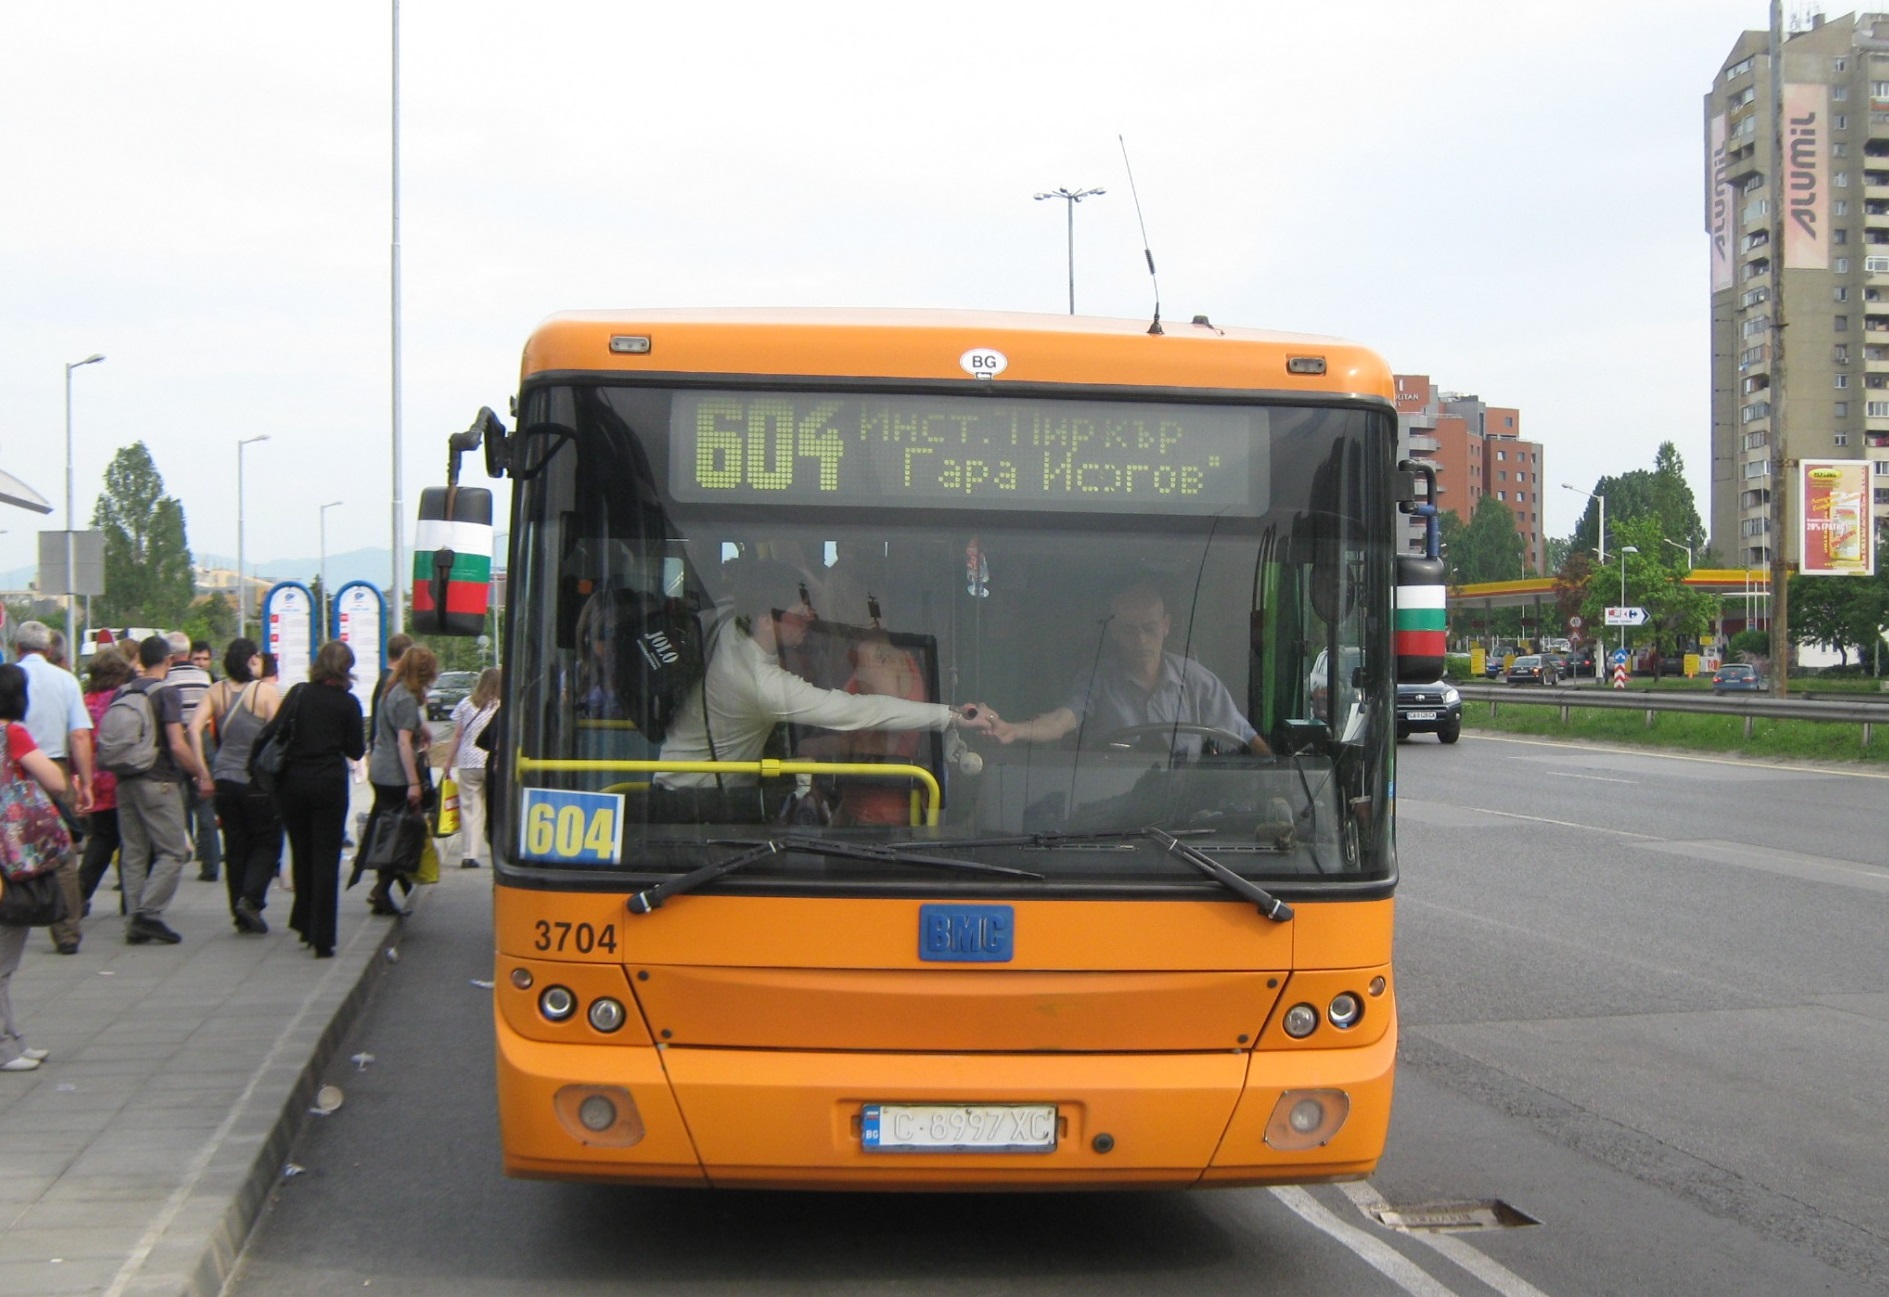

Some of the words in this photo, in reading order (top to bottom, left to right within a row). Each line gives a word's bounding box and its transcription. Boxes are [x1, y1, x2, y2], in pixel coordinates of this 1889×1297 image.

[972, 355, 997, 369] BG
[696, 399, 844, 491] 604
[905, 447, 1017, 494] Гара
[644, 630, 679, 663] JOLO
[527, 802, 615, 860] 604
[534, 919, 618, 954] 3704
[927, 914, 1006, 953] BMC
[865, 1130, 879, 1140] BG
[893, 1112, 914, 1141] C
[930, 1112, 1003, 1142] 8997
[1010, 1110, 1050, 1141] XC
